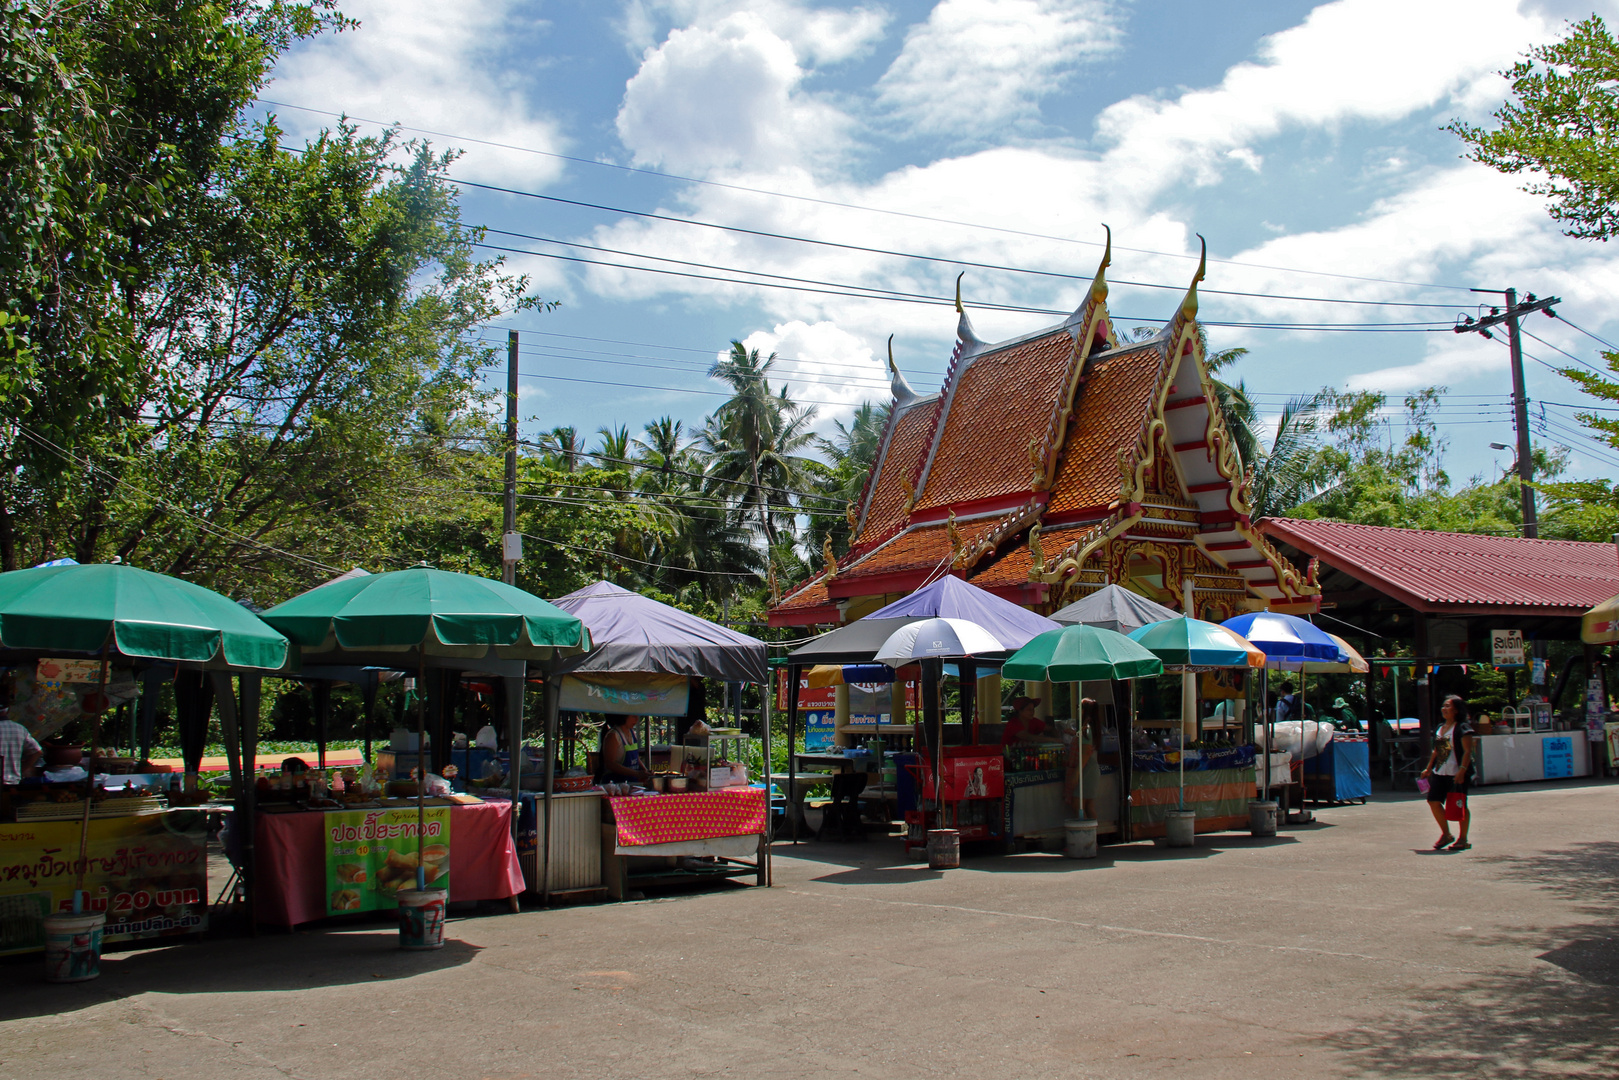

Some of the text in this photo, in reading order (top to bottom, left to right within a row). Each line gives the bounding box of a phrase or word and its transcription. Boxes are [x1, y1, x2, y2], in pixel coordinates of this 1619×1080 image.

[331, 811, 441, 843] ปอเปี๊ยะทอด
[391, 809, 445, 823] Sprin roll
[358, 846, 369, 855] 10
[115, 891, 150, 912] 20
[156, 887, 200, 907] บาท
[103, 910, 201, 936] หน่ายปลีก-ส่ง
